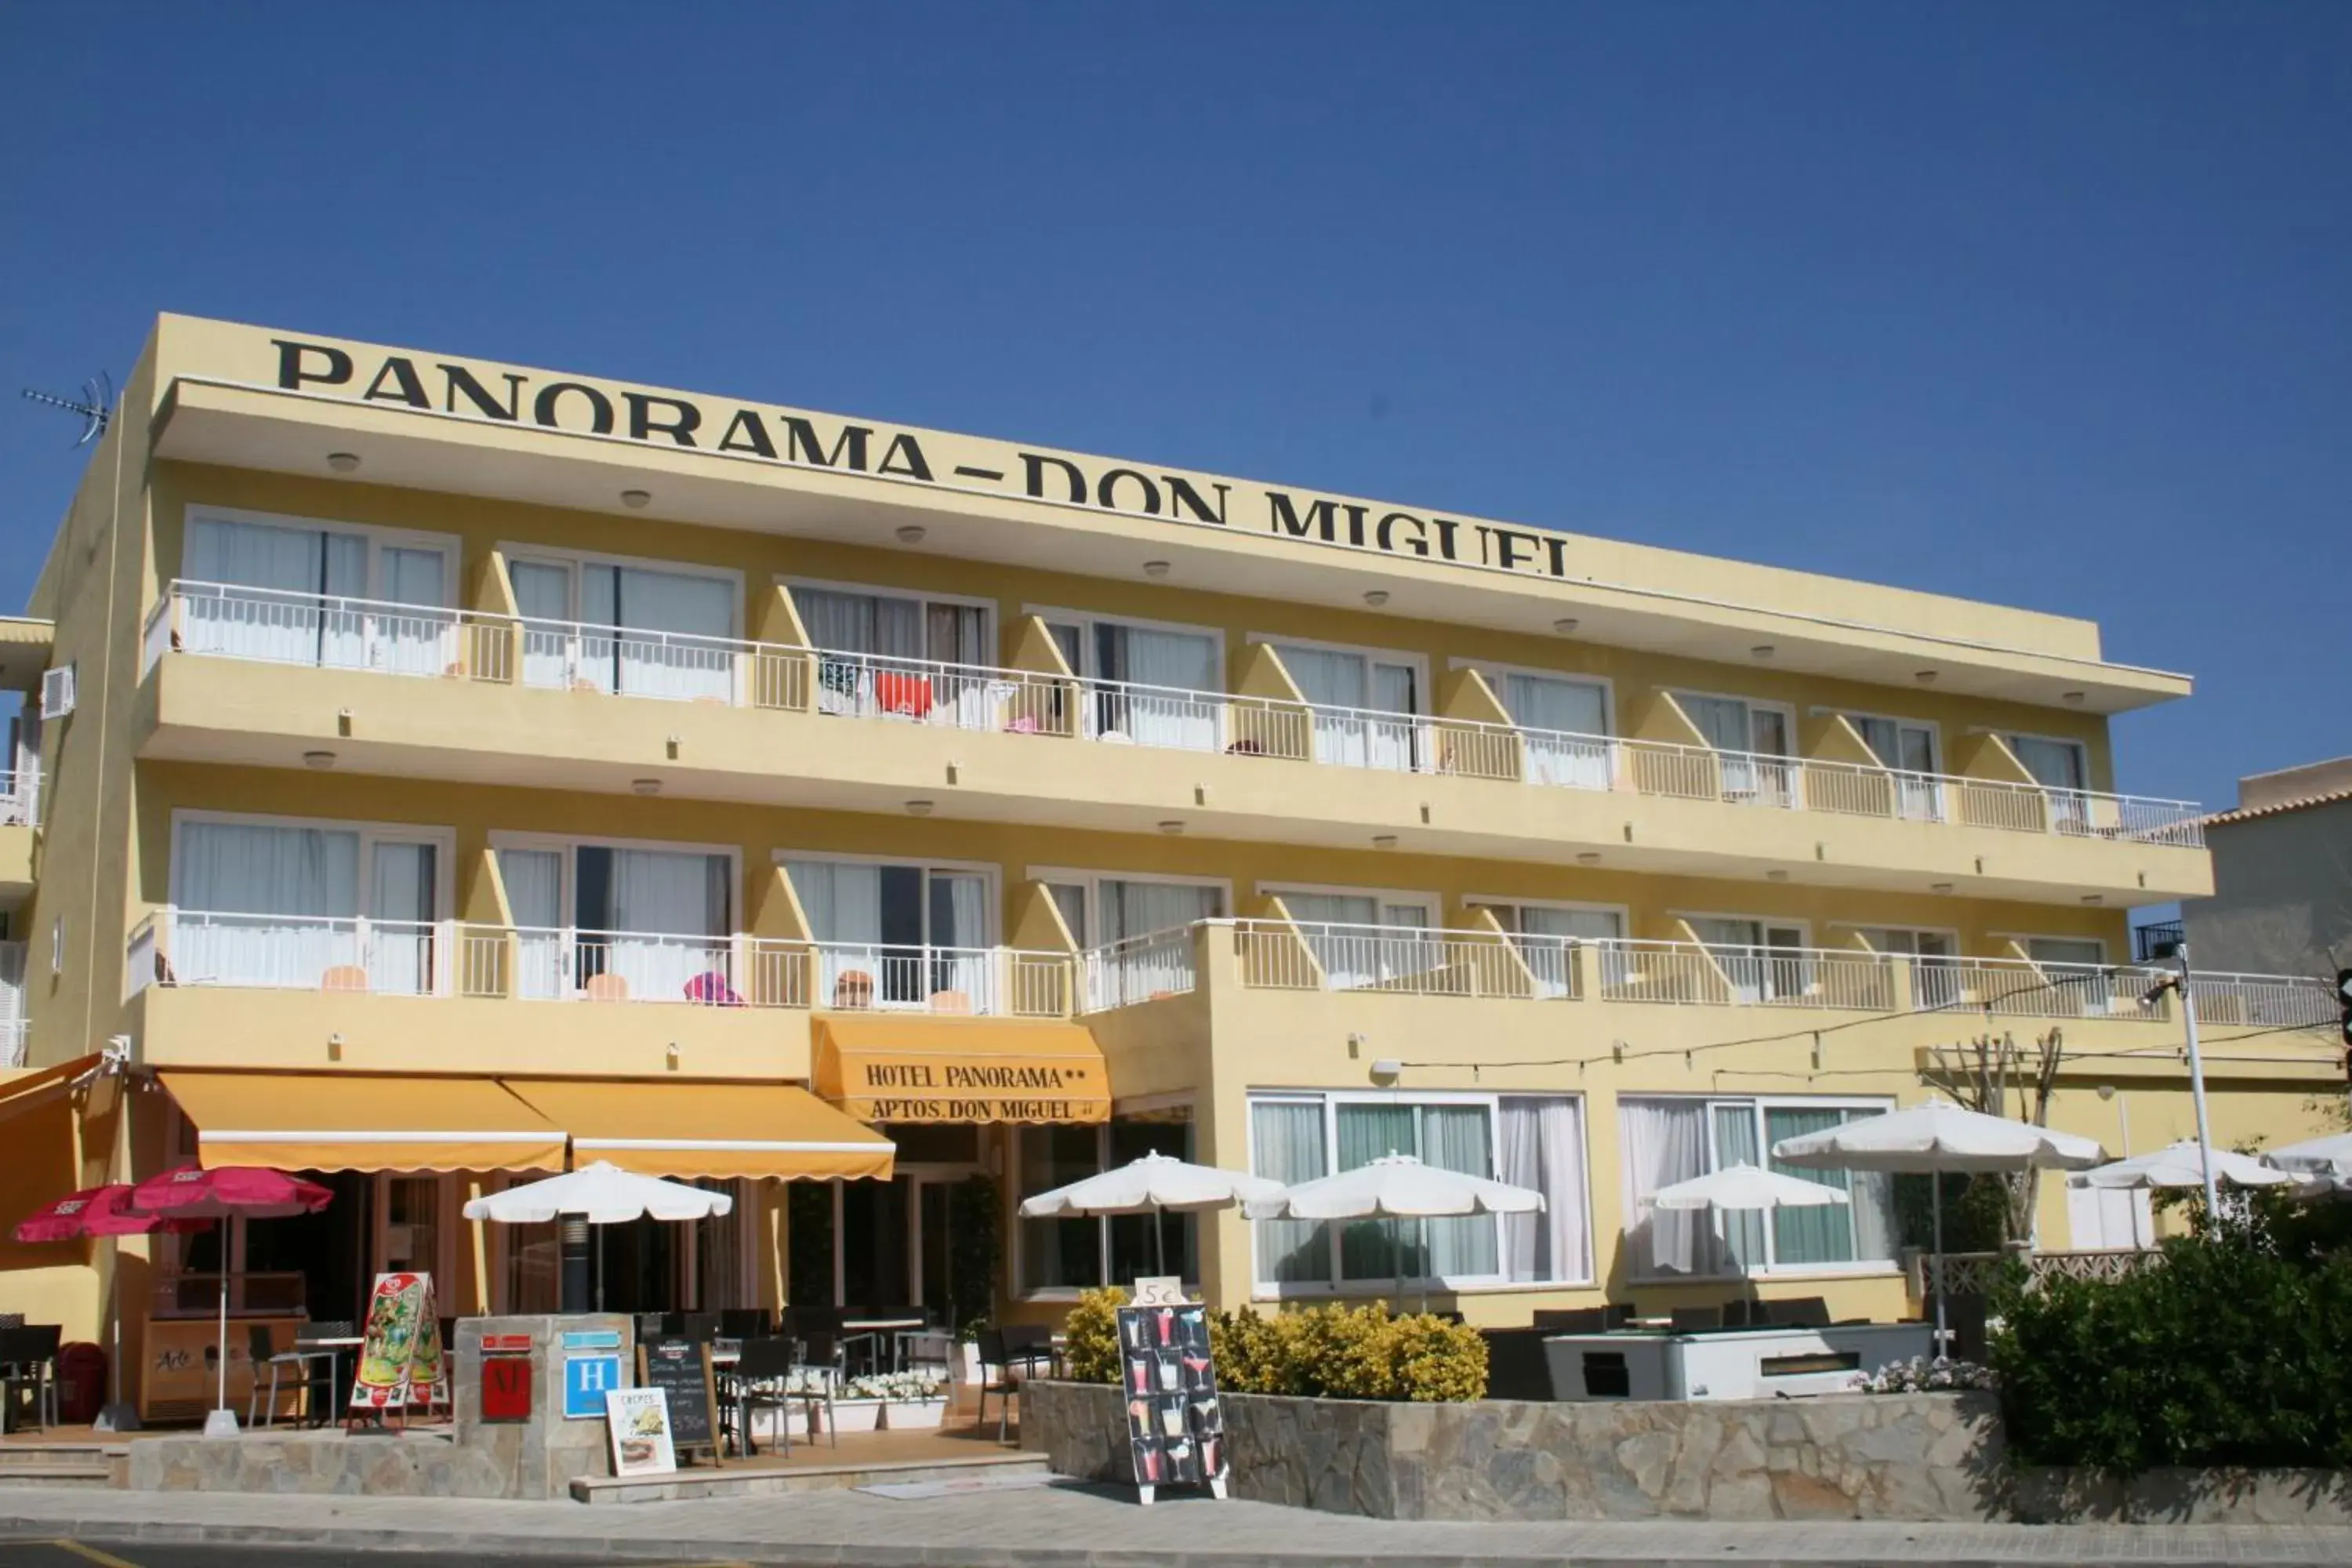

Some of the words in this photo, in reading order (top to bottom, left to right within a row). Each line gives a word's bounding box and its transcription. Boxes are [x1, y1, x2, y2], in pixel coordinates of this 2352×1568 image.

[270, 339, 935, 481] PANORAMA
[1017, 452, 1231, 525] DON
[866, 1065, 938, 1088] HOTEL
[948, 1100, 993, 1120] DON
[1000, 1101, 1074, 1118] MIGUEL
[580, 1362, 605, 1391] H
